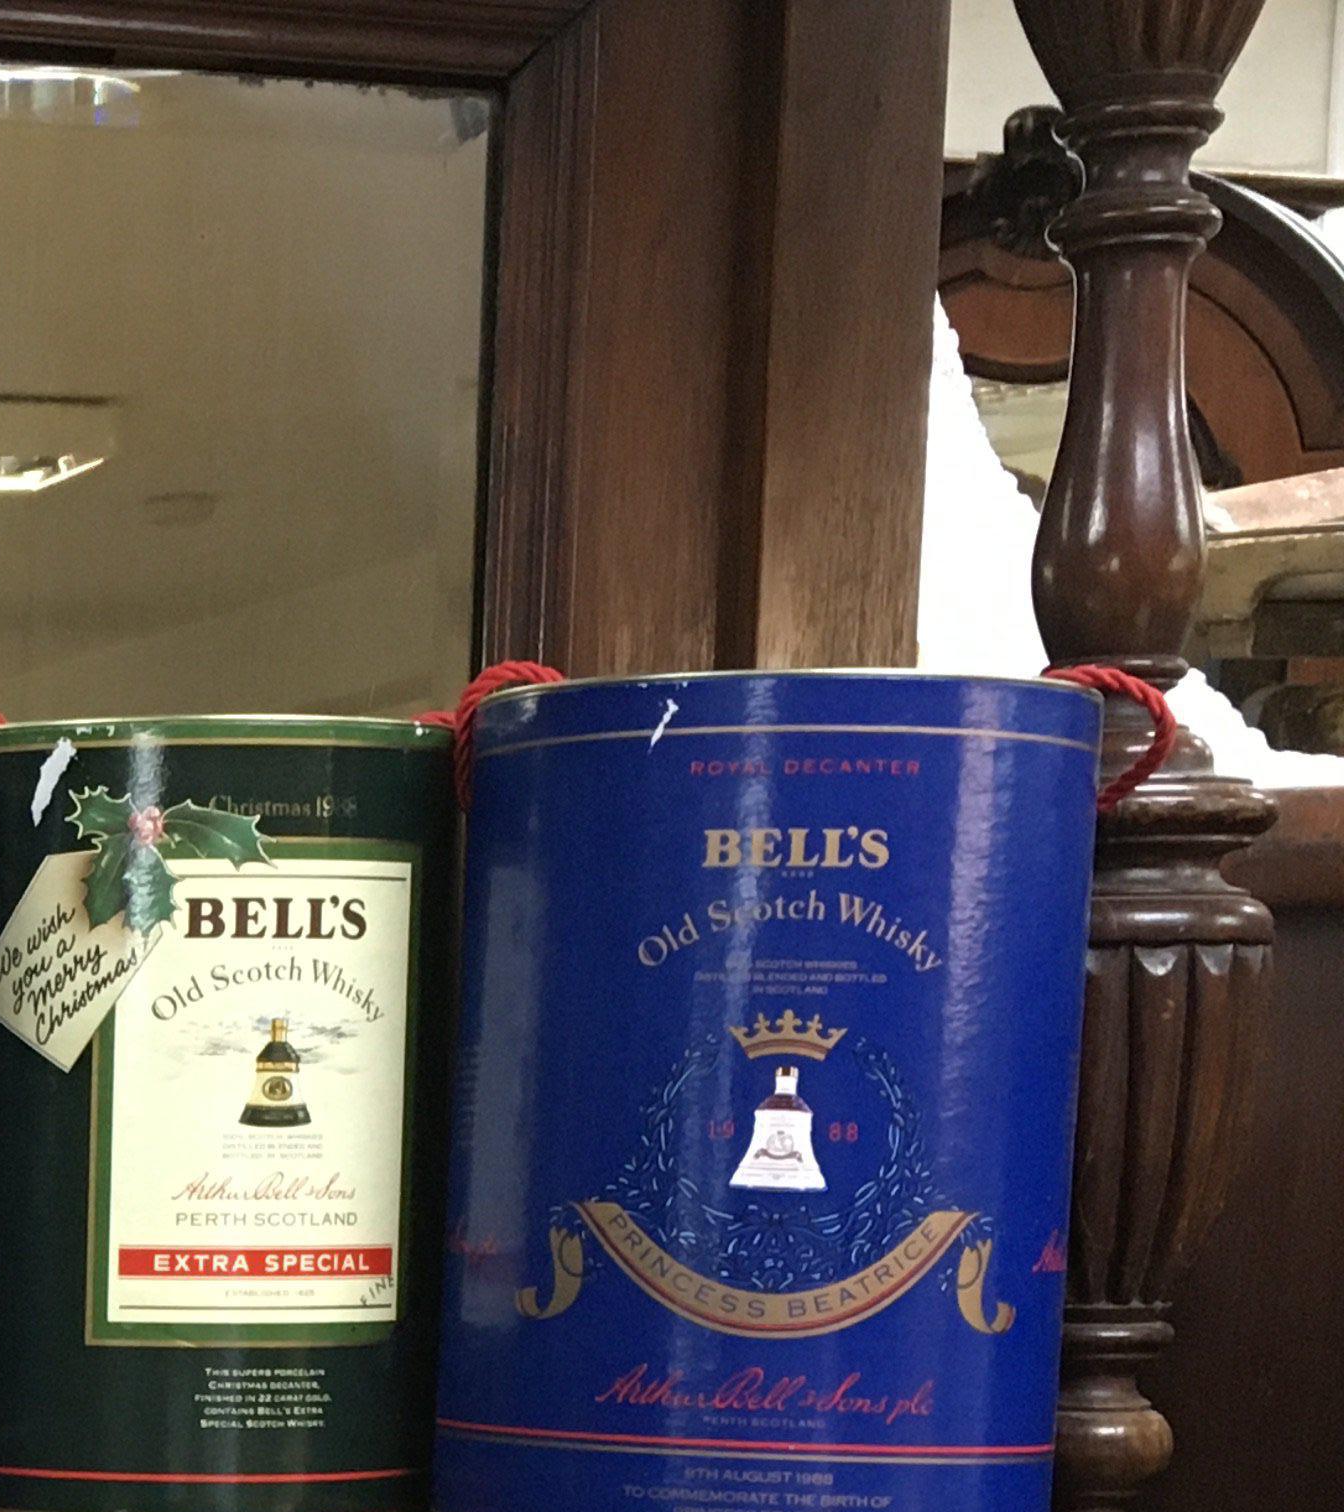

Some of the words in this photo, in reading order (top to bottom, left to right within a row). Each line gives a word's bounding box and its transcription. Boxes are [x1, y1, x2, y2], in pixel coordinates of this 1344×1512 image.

[690, 760, 771, 776] ROYAL
[785, 759, 920, 776] DECANTER
[702, 825, 889, 868] BELL'S
[27, 903, 77, 955] wish
[184, 893, 367, 941] BELL'S
[637, 913, 701, 968] Old
[707, 890, 825, 931] Scotch
[838, 892, 943, 974] Whisky
[12, 958, 52, 1015] you
[55, 933, 78, 960] a
[26, 940, 108, 1018] Merry
[35, 947, 138, 1046] Christmas
[151, 976, 203, 1022] Old
[210, 955, 303, 993] Scotch
[310, 957, 386, 1024] Whisky
[828, 1122, 859, 1142] 88
[175, 1212, 248, 1227] PERTH
[253, 1211, 359, 1227] SCOTLAND
[153, 1254, 250, 1272] EXTRA
[264, 1253, 370, 1272] SPECIAL
[608, 1212, 767, 1319] PRINCESS
[787, 1226, 940, 1318] BEATRICE
